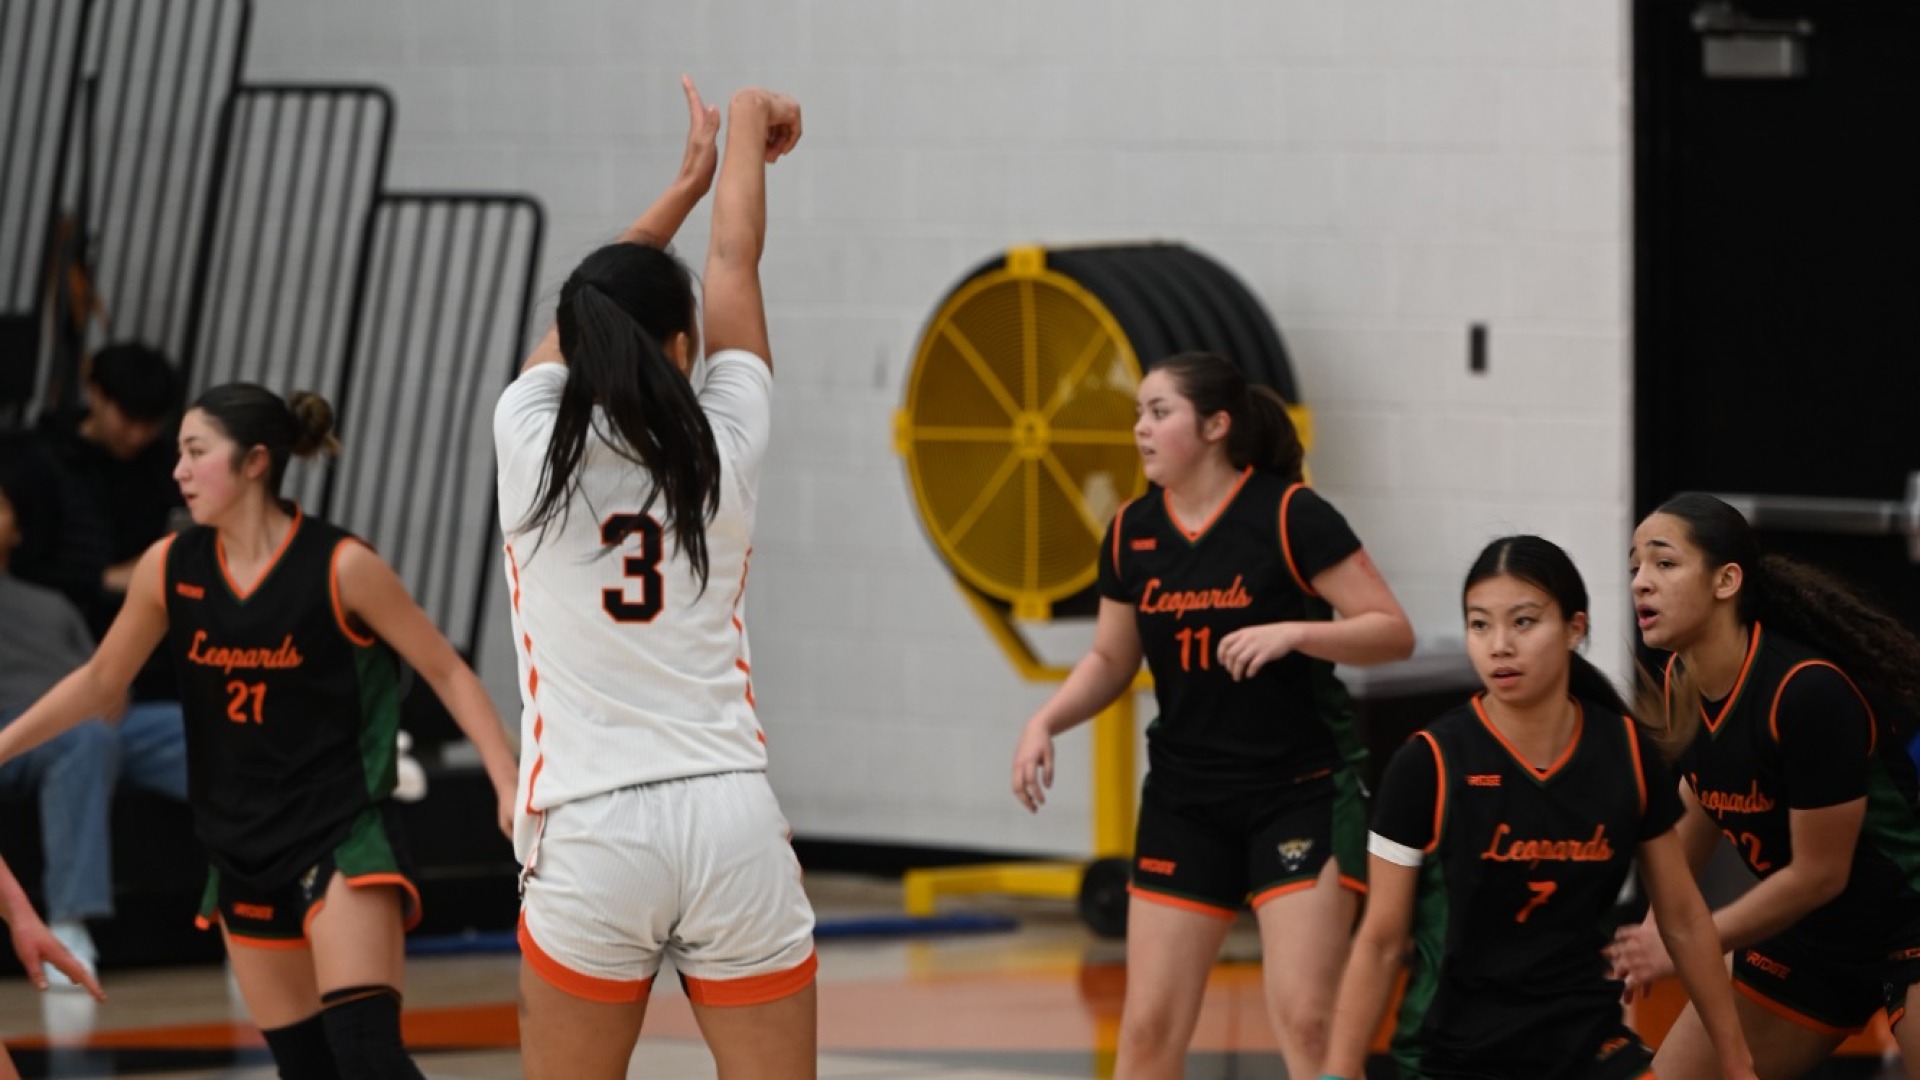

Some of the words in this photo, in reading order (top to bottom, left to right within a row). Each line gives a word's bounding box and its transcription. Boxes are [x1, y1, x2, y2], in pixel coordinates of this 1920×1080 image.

[601, 512, 664, 624] 3
[1139, 574, 1253, 620] Leopards
[188, 629, 304, 675] Leopards
[1175, 626, 1211, 672] 11
[226, 680, 267, 724] 21
[1480, 823, 1614, 869] Leopards
[1515, 881, 1557, 923] 7
